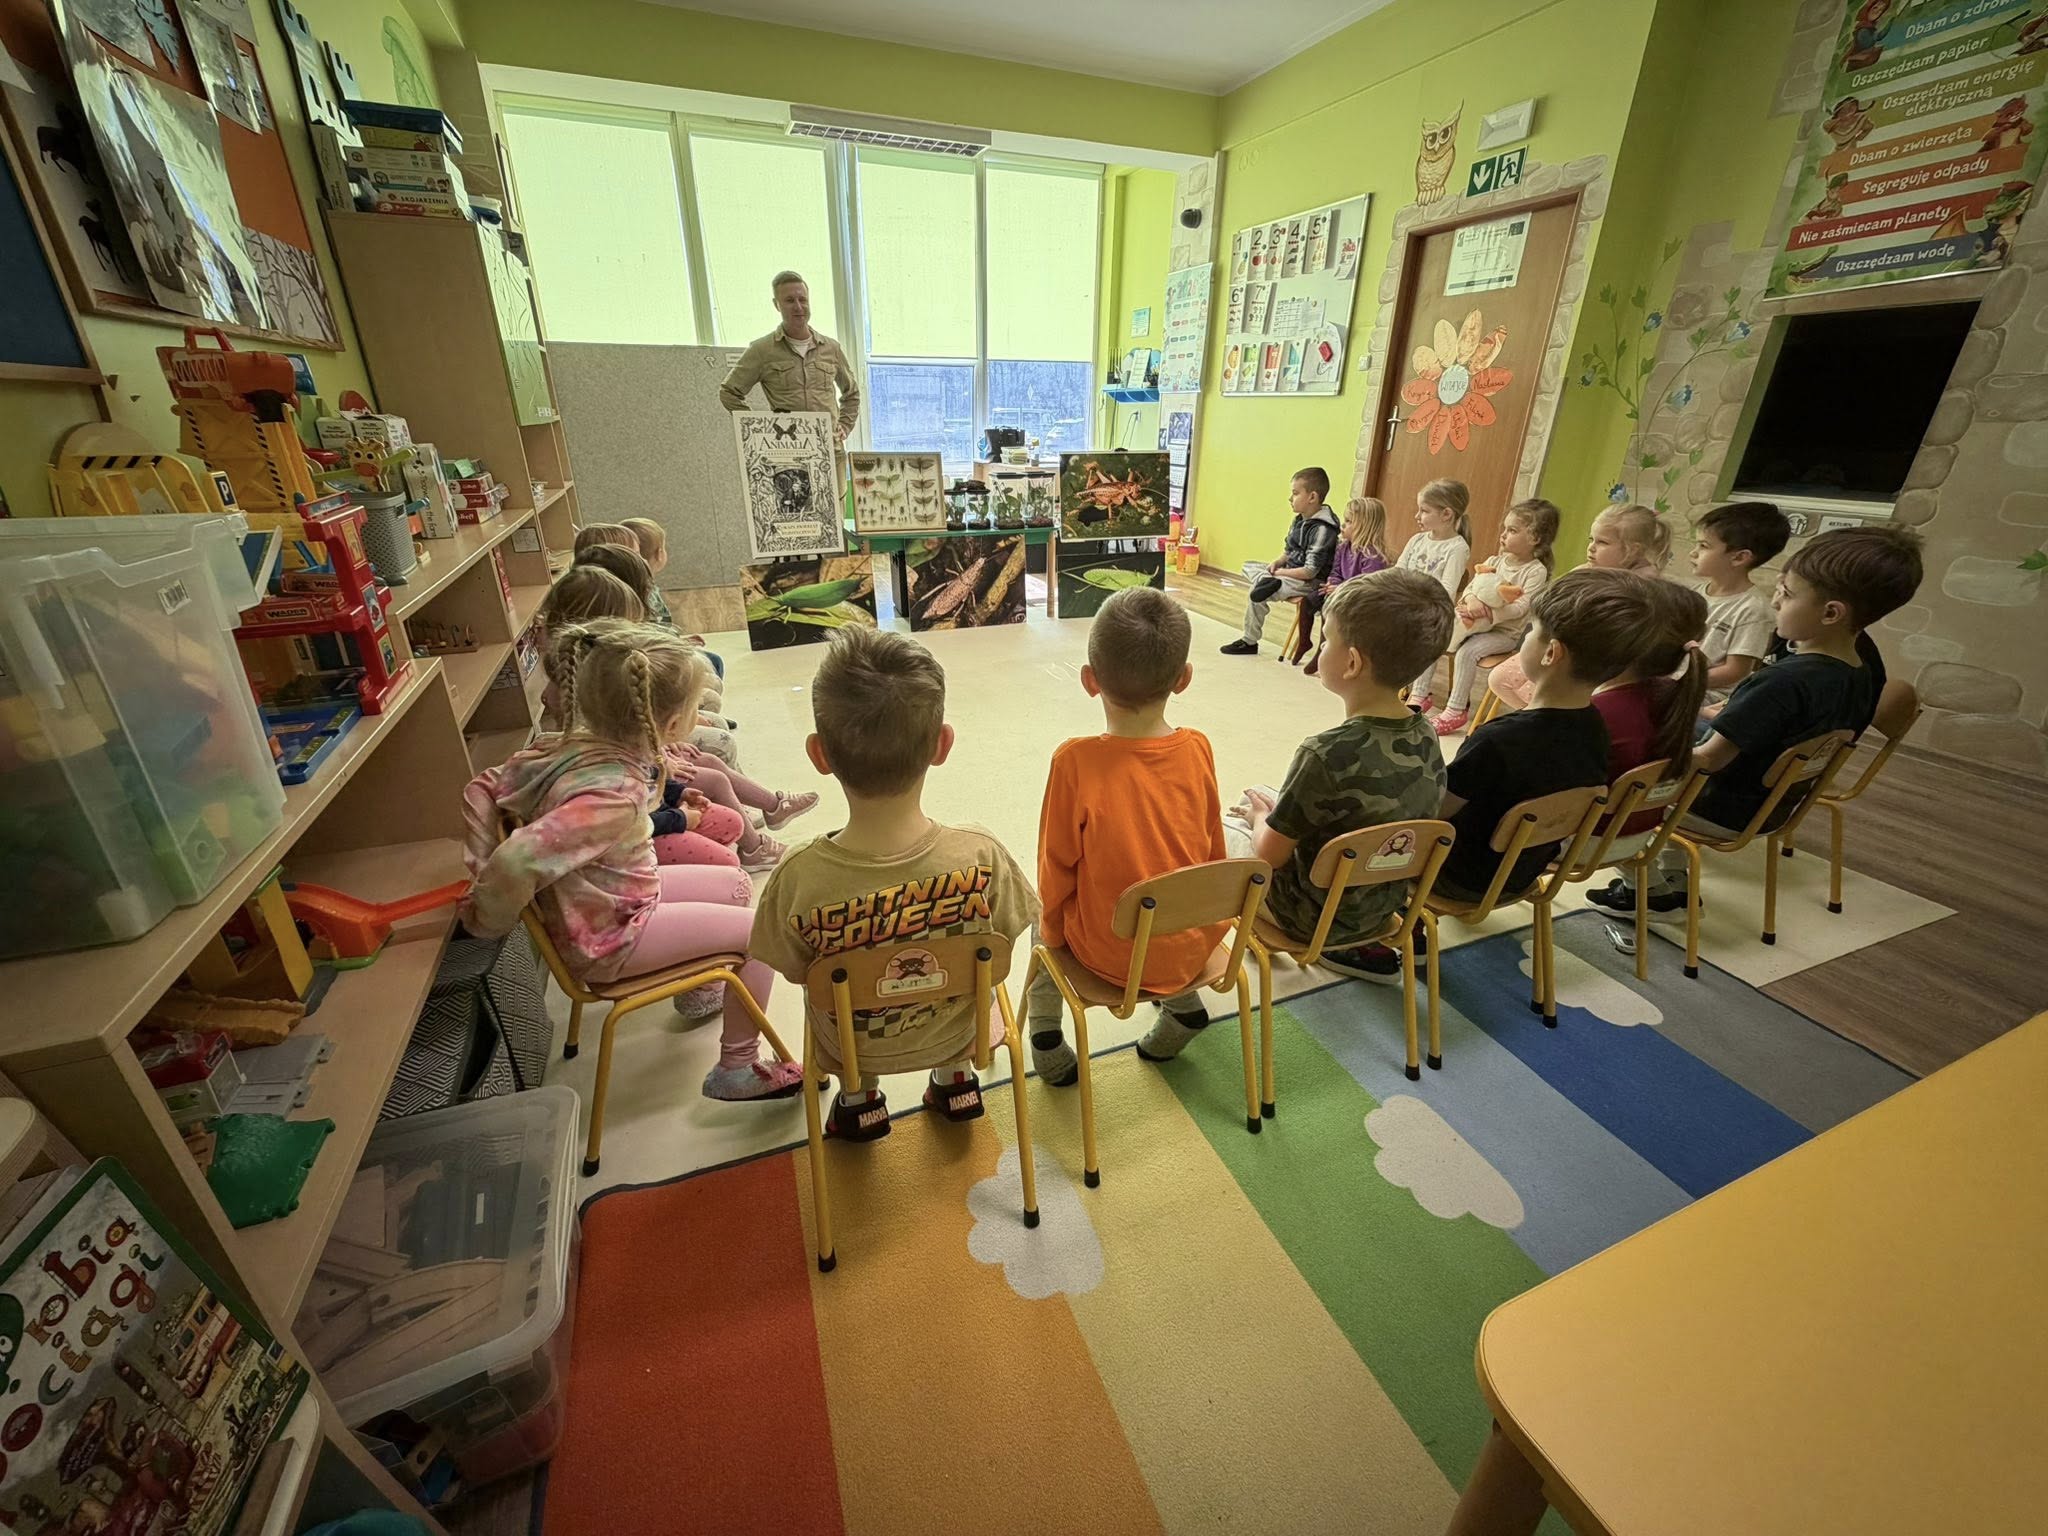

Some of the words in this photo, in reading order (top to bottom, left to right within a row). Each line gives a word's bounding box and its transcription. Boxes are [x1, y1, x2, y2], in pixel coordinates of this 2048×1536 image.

[1905, 17, 1947, 39] Dbam
[1951, 11, 1960, 22] o
[1963, 0, 2015, 19] zdrow
[1851, 54, 1935, 88] Oszczędzam
[1937, 36, 1989, 66] papier
[1882, 78, 1969, 110] Oszczędzam
[1972, 58, 2035, 86] energię
[1905, 86, 1993, 118] elektryczną
[1850, 145, 1888, 166] Dbam
[1890, 145, 1899, 155] o
[1902, 126, 1973, 153] zwierzęta
[1862, 170, 1930, 195] Segreguję
[1933, 156, 1990, 179] odpady
[1254, 230, 1263, 247] 2
[1273, 228, 1281, 245] 3
[1291, 223, 1300, 240] 4
[1312, 217, 1322, 235] 5
[1798, 229, 1819, 244] Nie
[1821, 216, 1893, 240] zaśmiecam
[1895, 205, 1951, 227] planety
[1836, 251, 1914, 273] Oszczędzam
[1917, 243, 1956, 261] wodę
[1232, 288, 1239, 303] 6
[219, 481, 229, 501] P
[314, 580, 339, 588] WAD
[0, 1242, 164, 1484] ociągi
